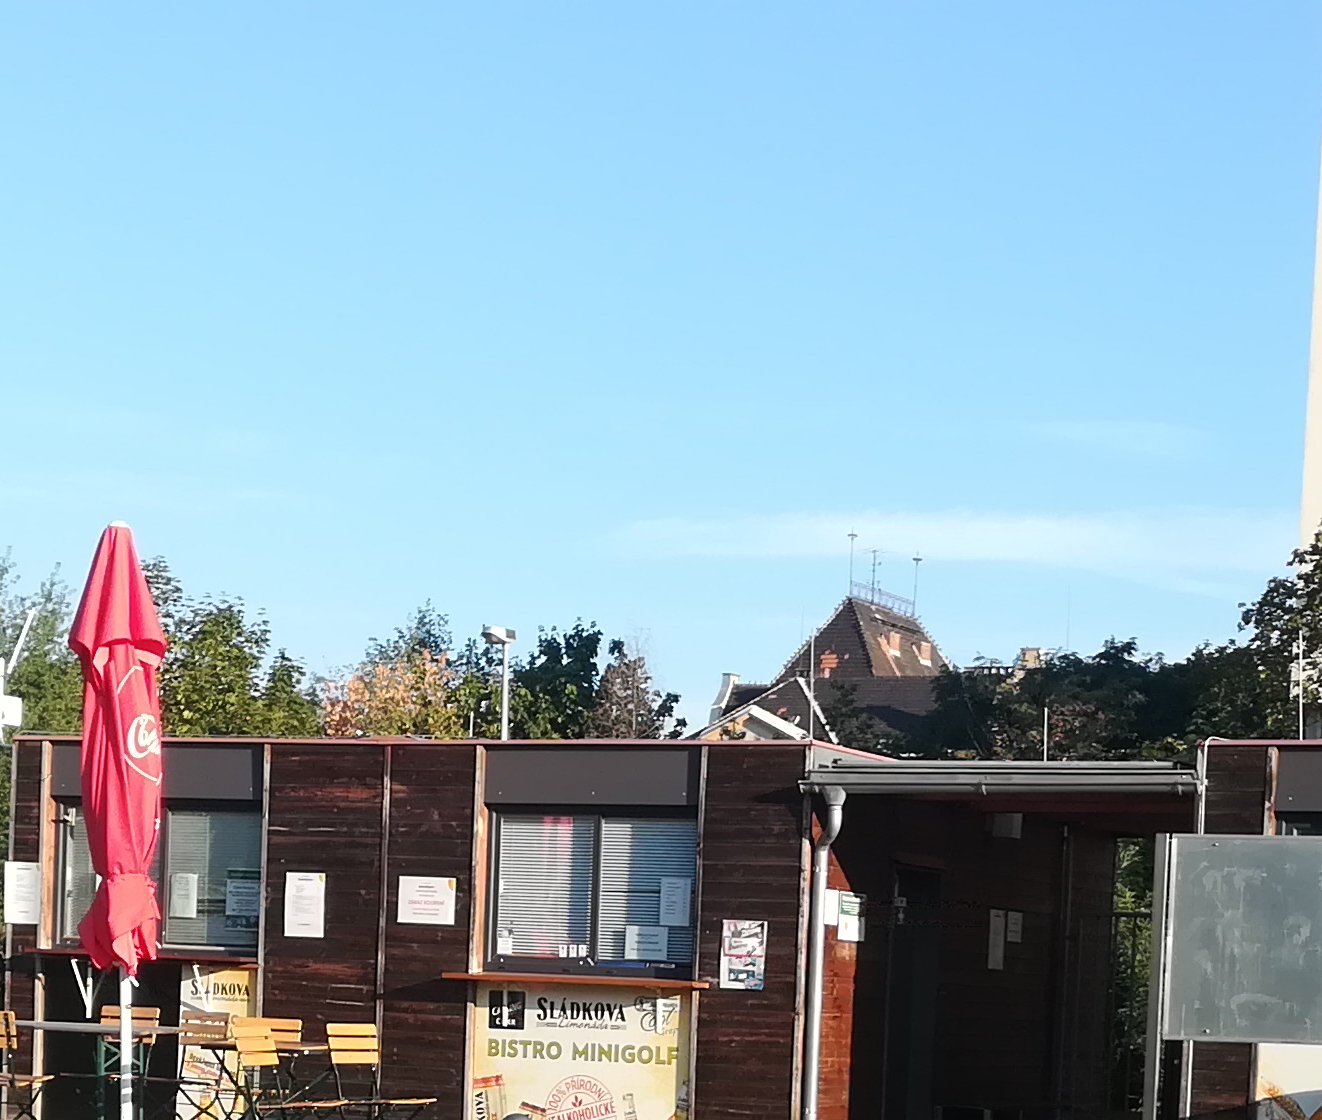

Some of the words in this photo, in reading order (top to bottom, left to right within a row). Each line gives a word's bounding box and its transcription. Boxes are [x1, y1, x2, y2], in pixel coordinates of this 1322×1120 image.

[487, 1038, 563, 1060] BISTRO
[571, 1042, 679, 1066] MINIGOLF
[547, 1087, 567, 1112] 100%
